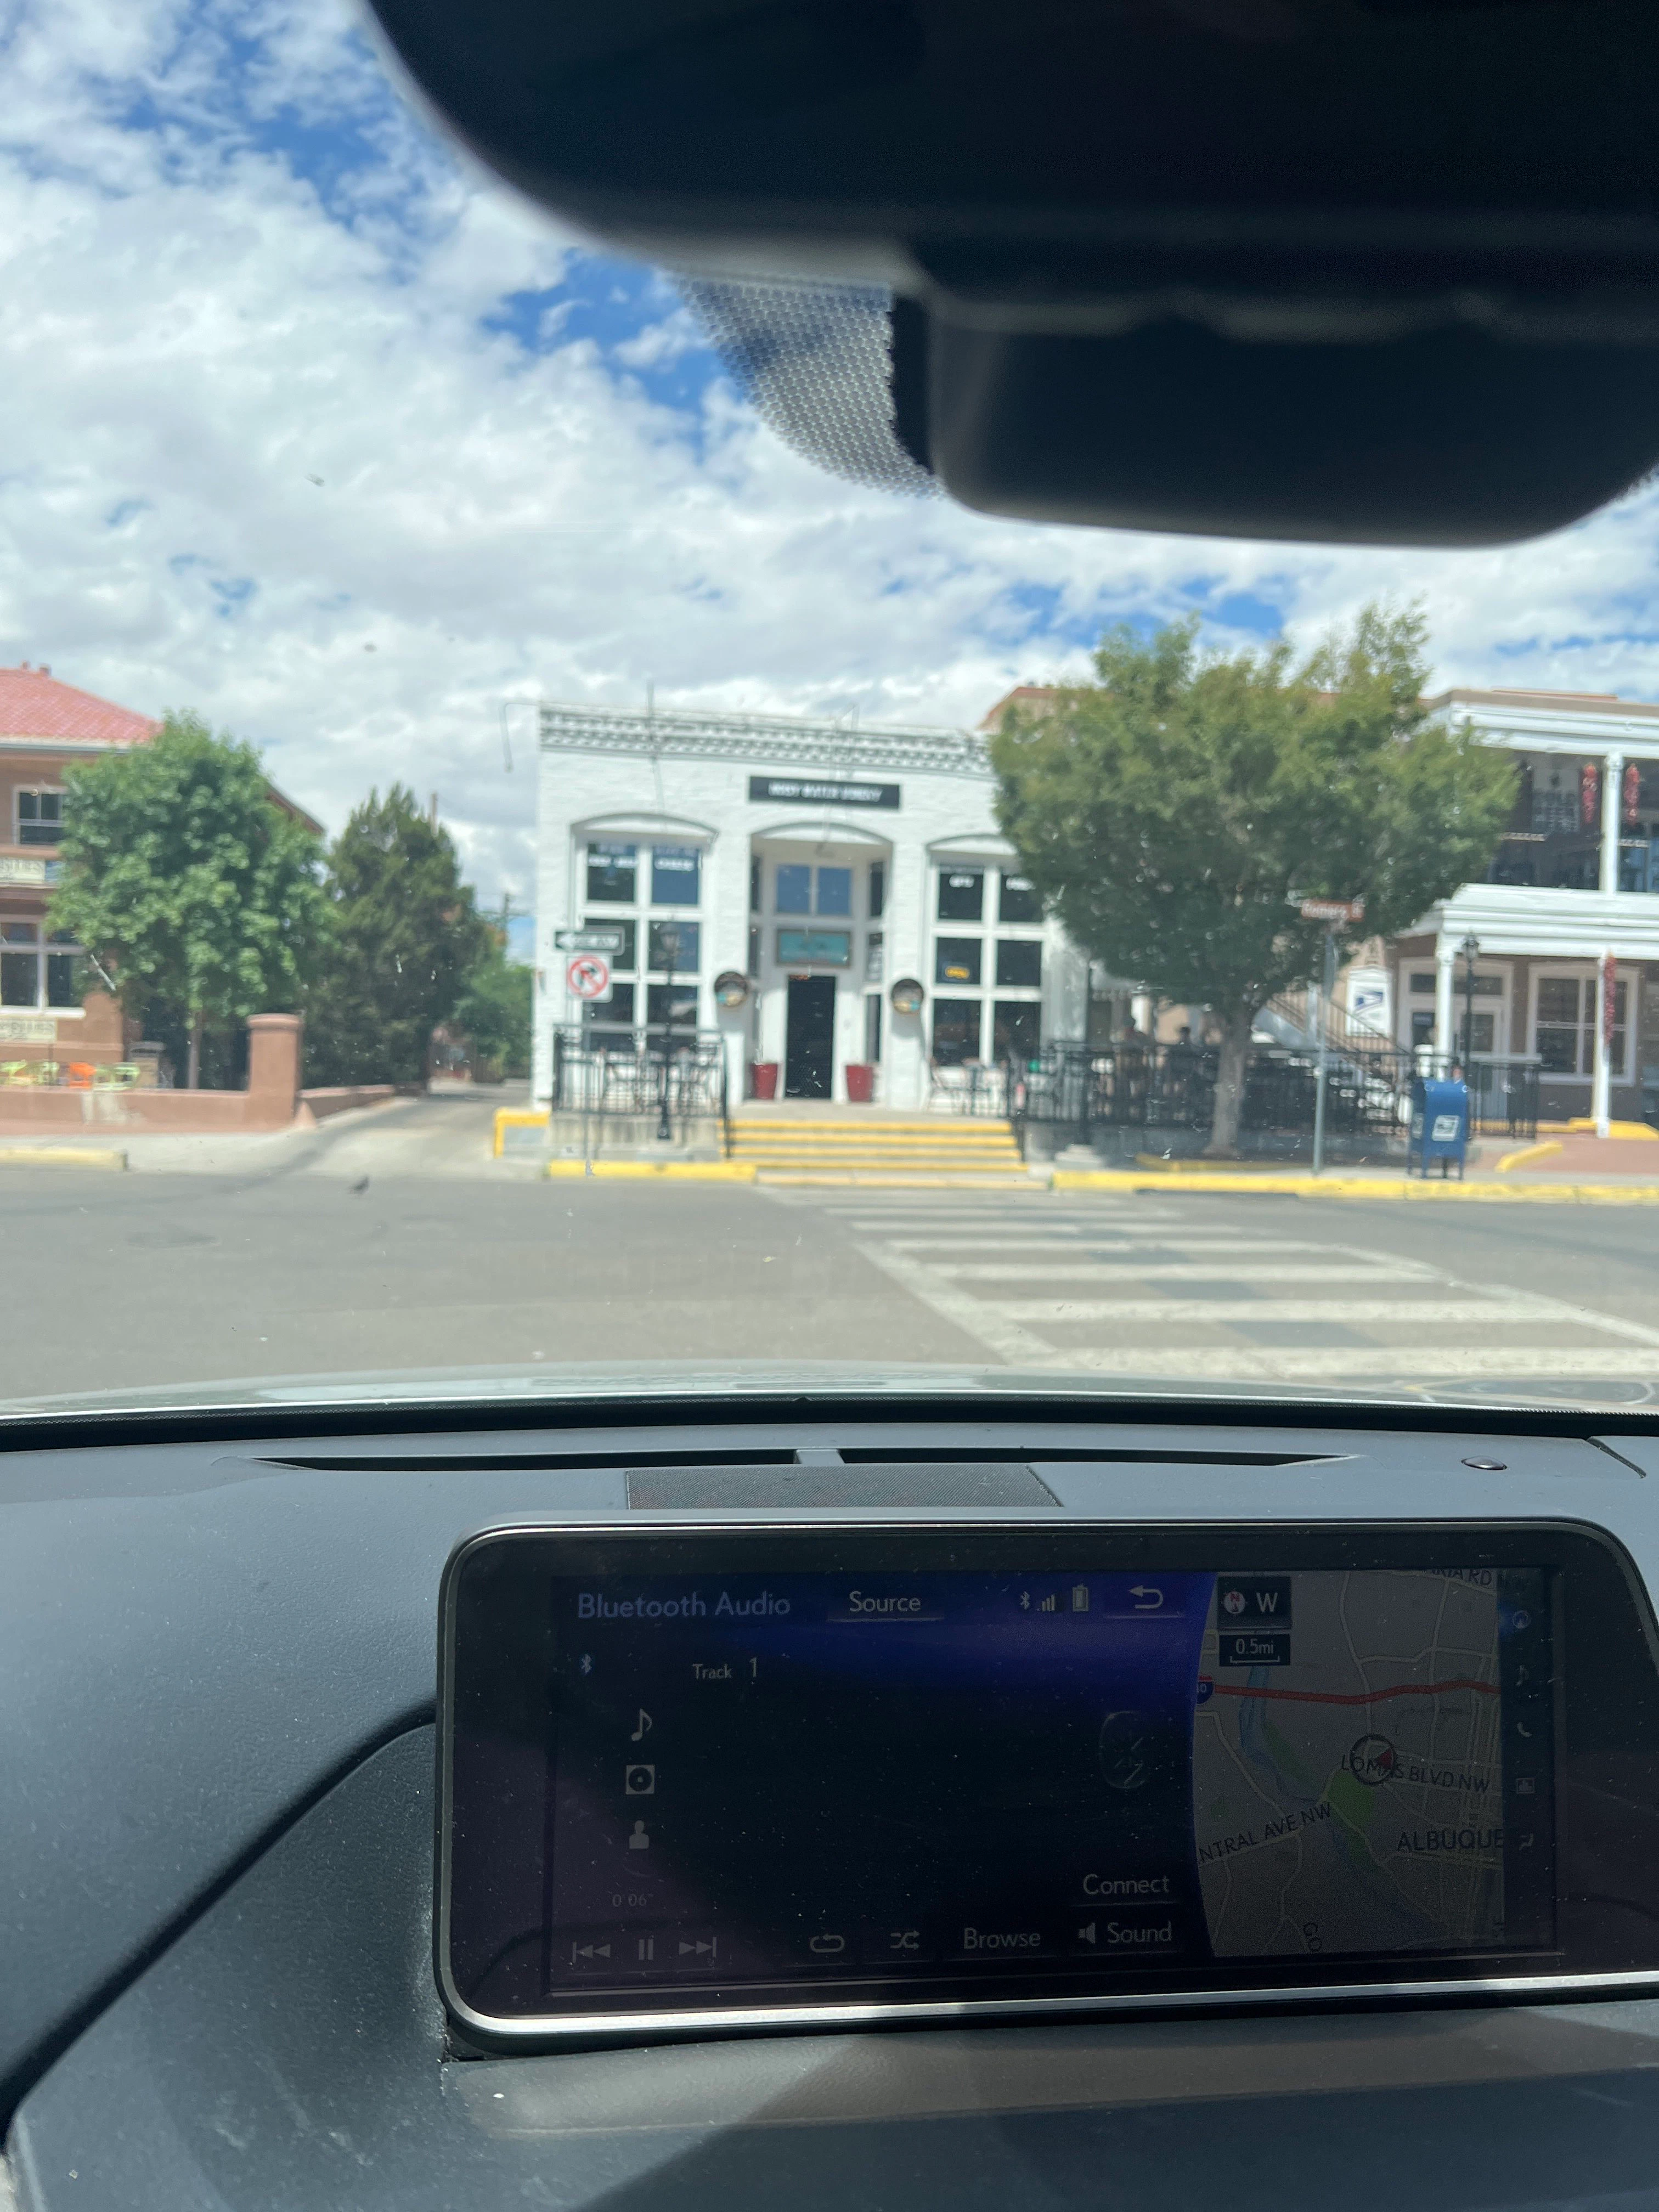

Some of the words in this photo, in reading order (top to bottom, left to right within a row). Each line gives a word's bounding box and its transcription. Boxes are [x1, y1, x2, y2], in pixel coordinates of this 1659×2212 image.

[578, 1592, 706, 1619] Bluetooth
[715, 1590, 791, 1616] Audio
[849, 1591, 922, 1613] Source
[1255, 1592, 1278, 1613] W
[692, 1662, 732, 1680] Track
[749, 1656, 758, 1678] 1
[1408, 1765, 1453, 1787] BLVD
[1459, 1774, 1490, 1793] NW
[1263, 1814, 1296, 1839] AVE
[1300, 1802, 1330, 1826] NW
[1397, 1829, 1504, 1852] ALBUQUE
[1082, 1873, 1170, 1895] Connect
[963, 1927, 1041, 1949] Browse
[1107, 1921, 1172, 1944] Sound
